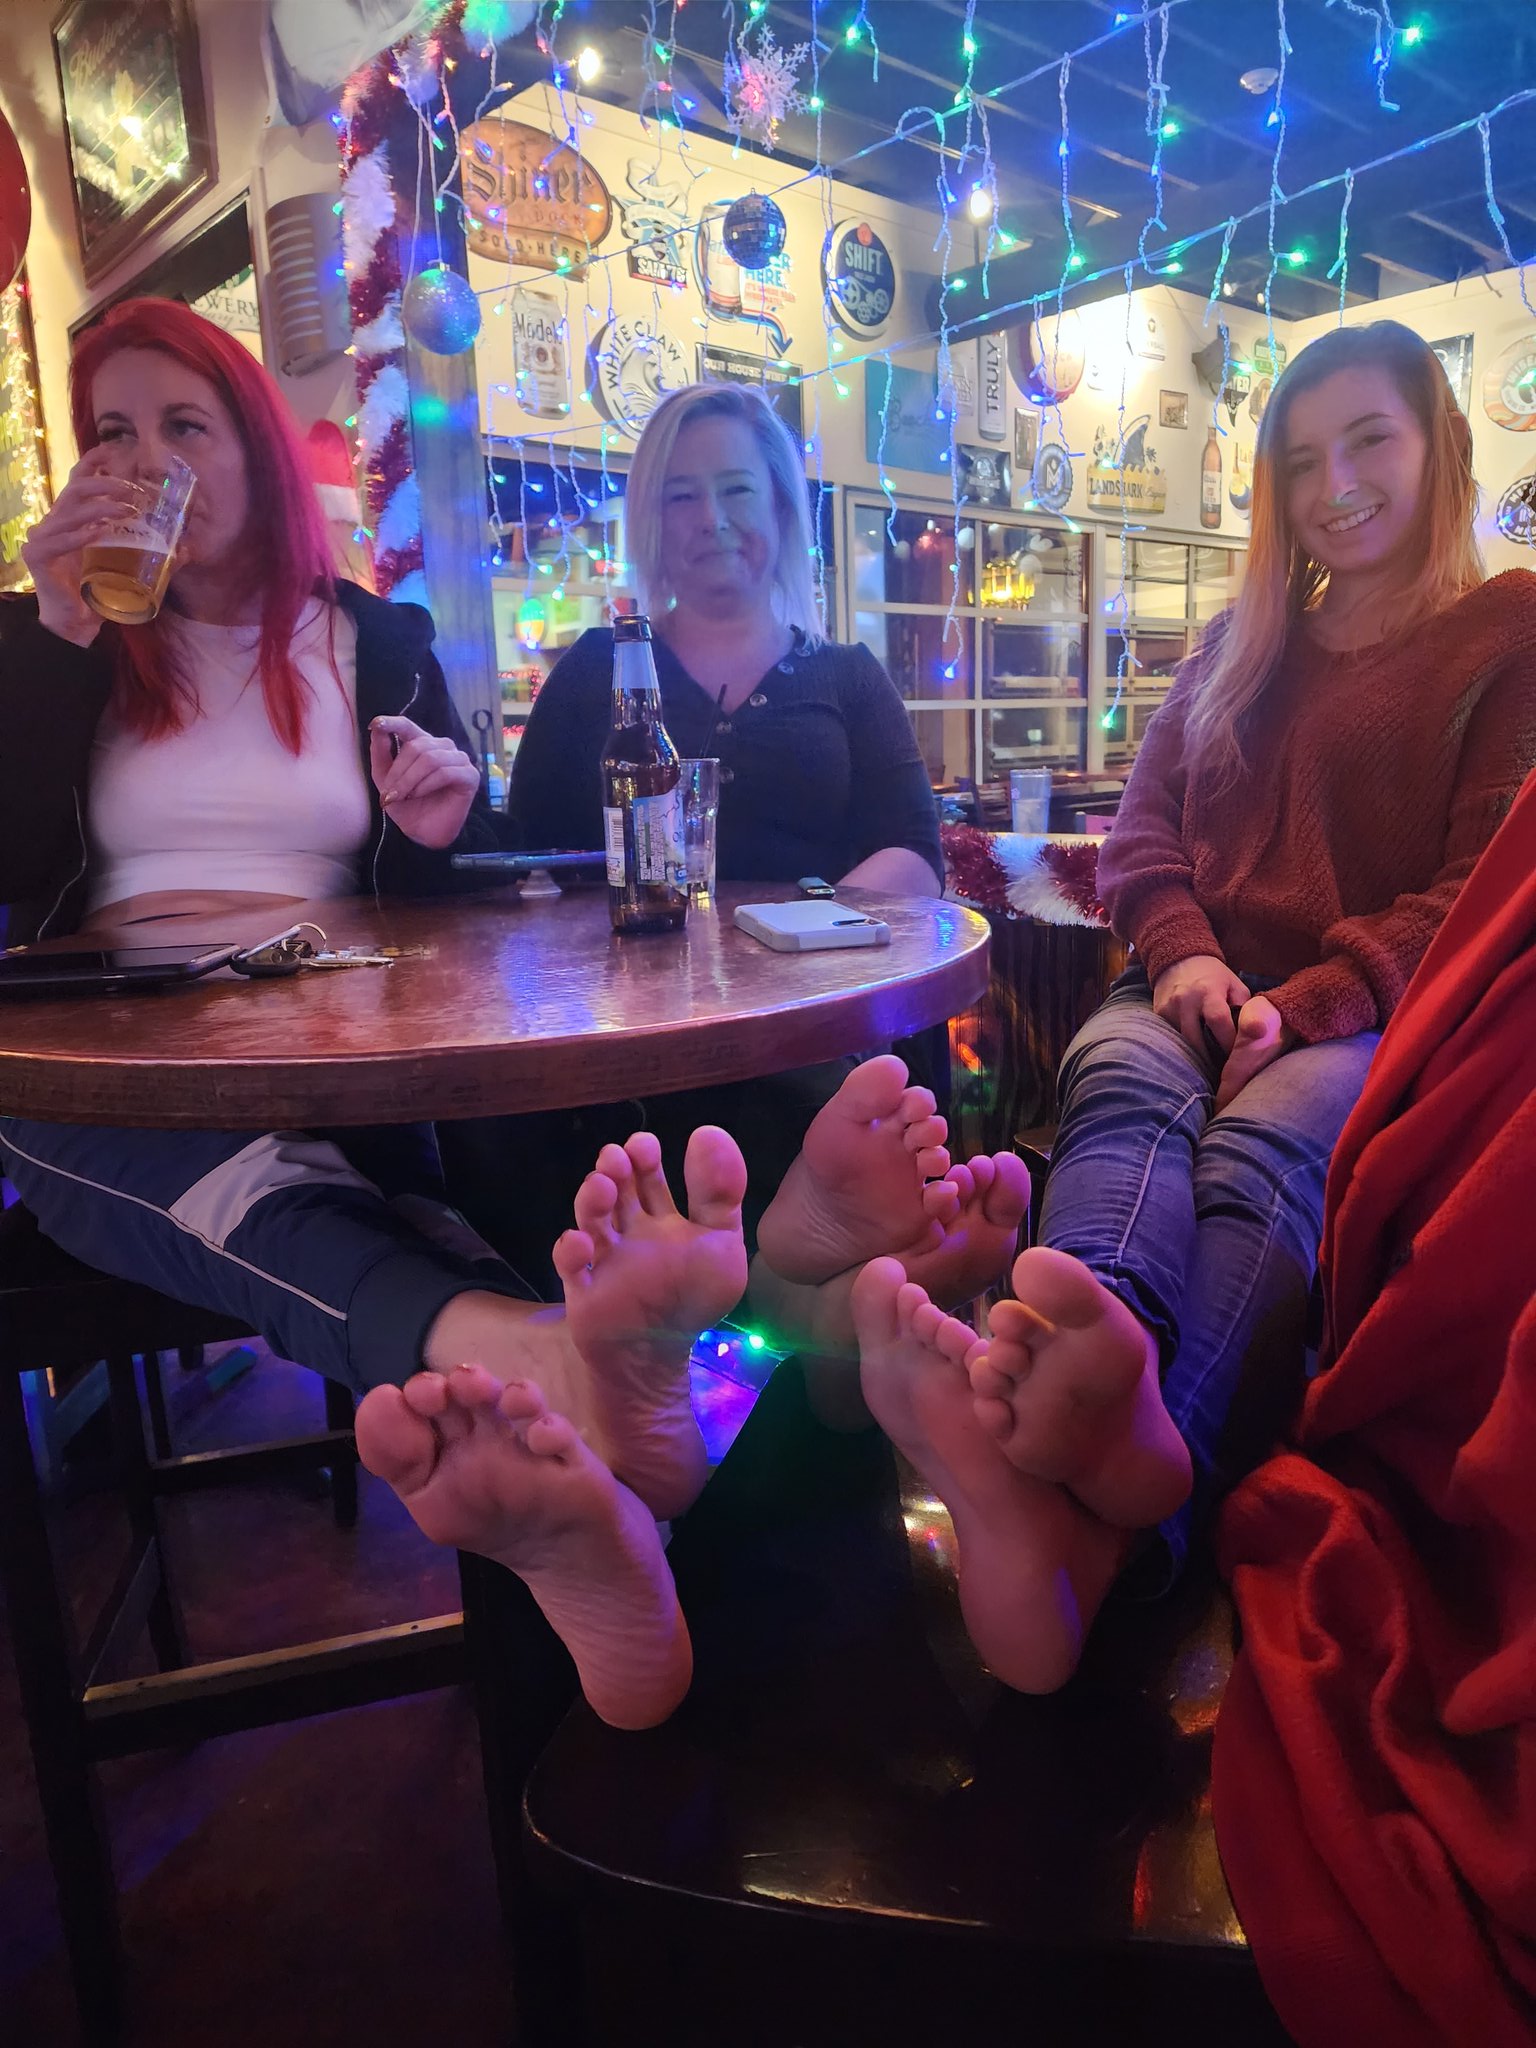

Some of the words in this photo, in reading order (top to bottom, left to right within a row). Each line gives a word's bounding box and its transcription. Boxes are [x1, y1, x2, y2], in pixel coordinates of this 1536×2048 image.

[637, 257, 688, 284] SAINTS
[845, 241, 884, 276] SHIFT
[514, 311, 563, 344] Model
[605, 324, 632, 389] WHITE
[634, 320, 682, 361] CLAW
[986, 339, 999, 415] TRULY
